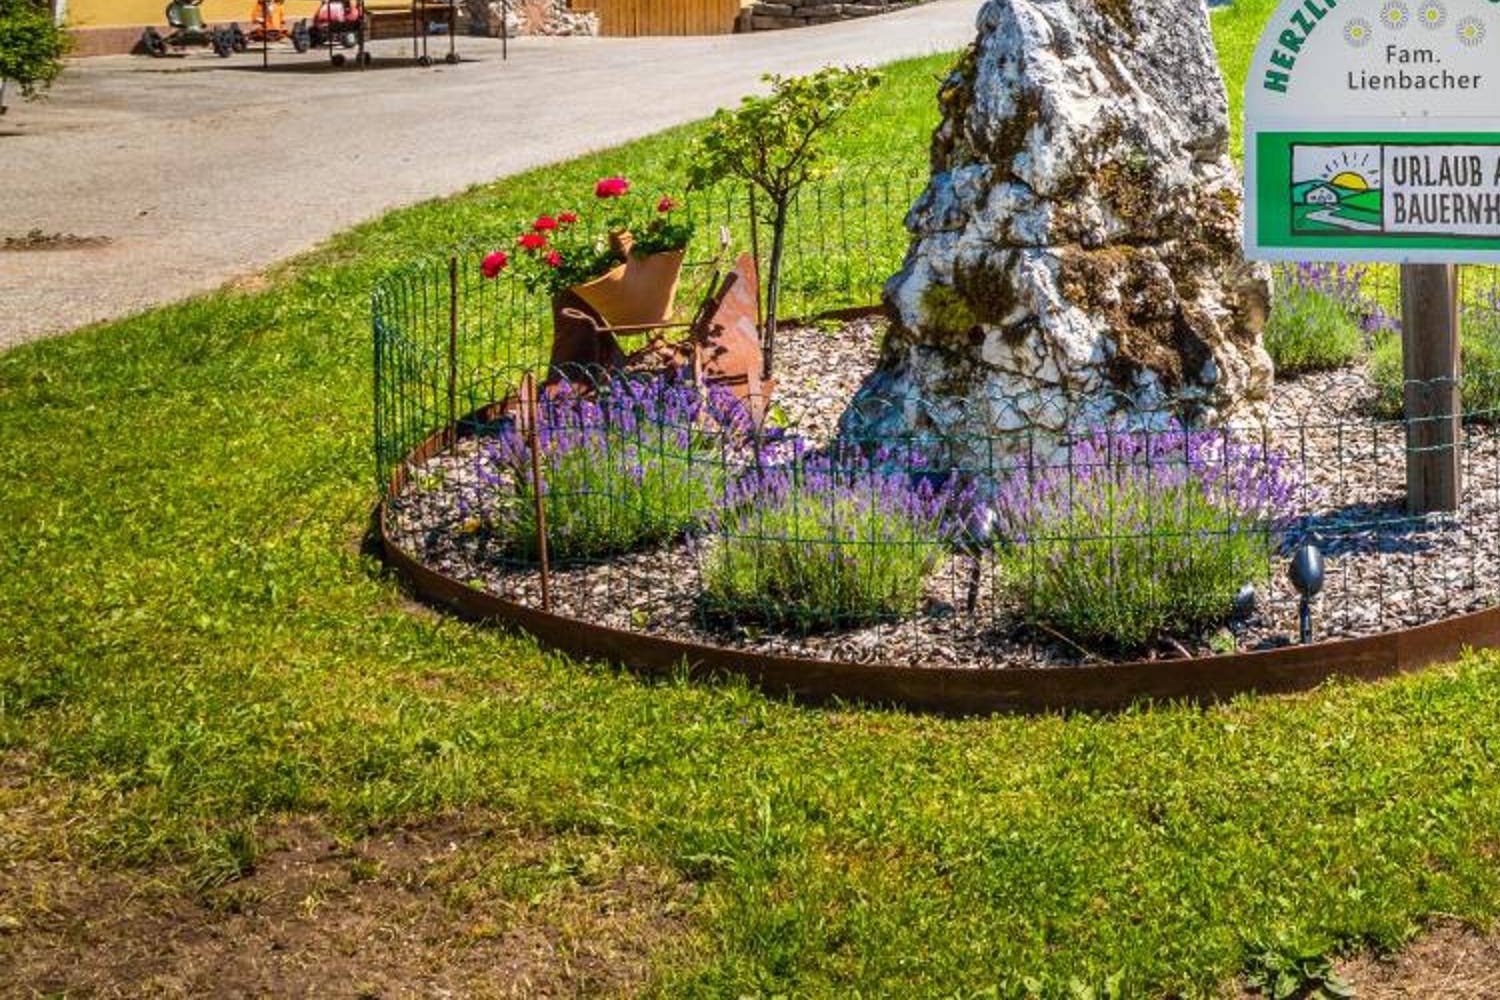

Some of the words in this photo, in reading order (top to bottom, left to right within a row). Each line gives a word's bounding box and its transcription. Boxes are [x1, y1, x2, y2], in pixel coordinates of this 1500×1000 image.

[1386, 44, 1441, 64] Fam.
[1347, 69, 1482, 90] Lienbacher
[1393, 155, 1482, 187] URLAUB
